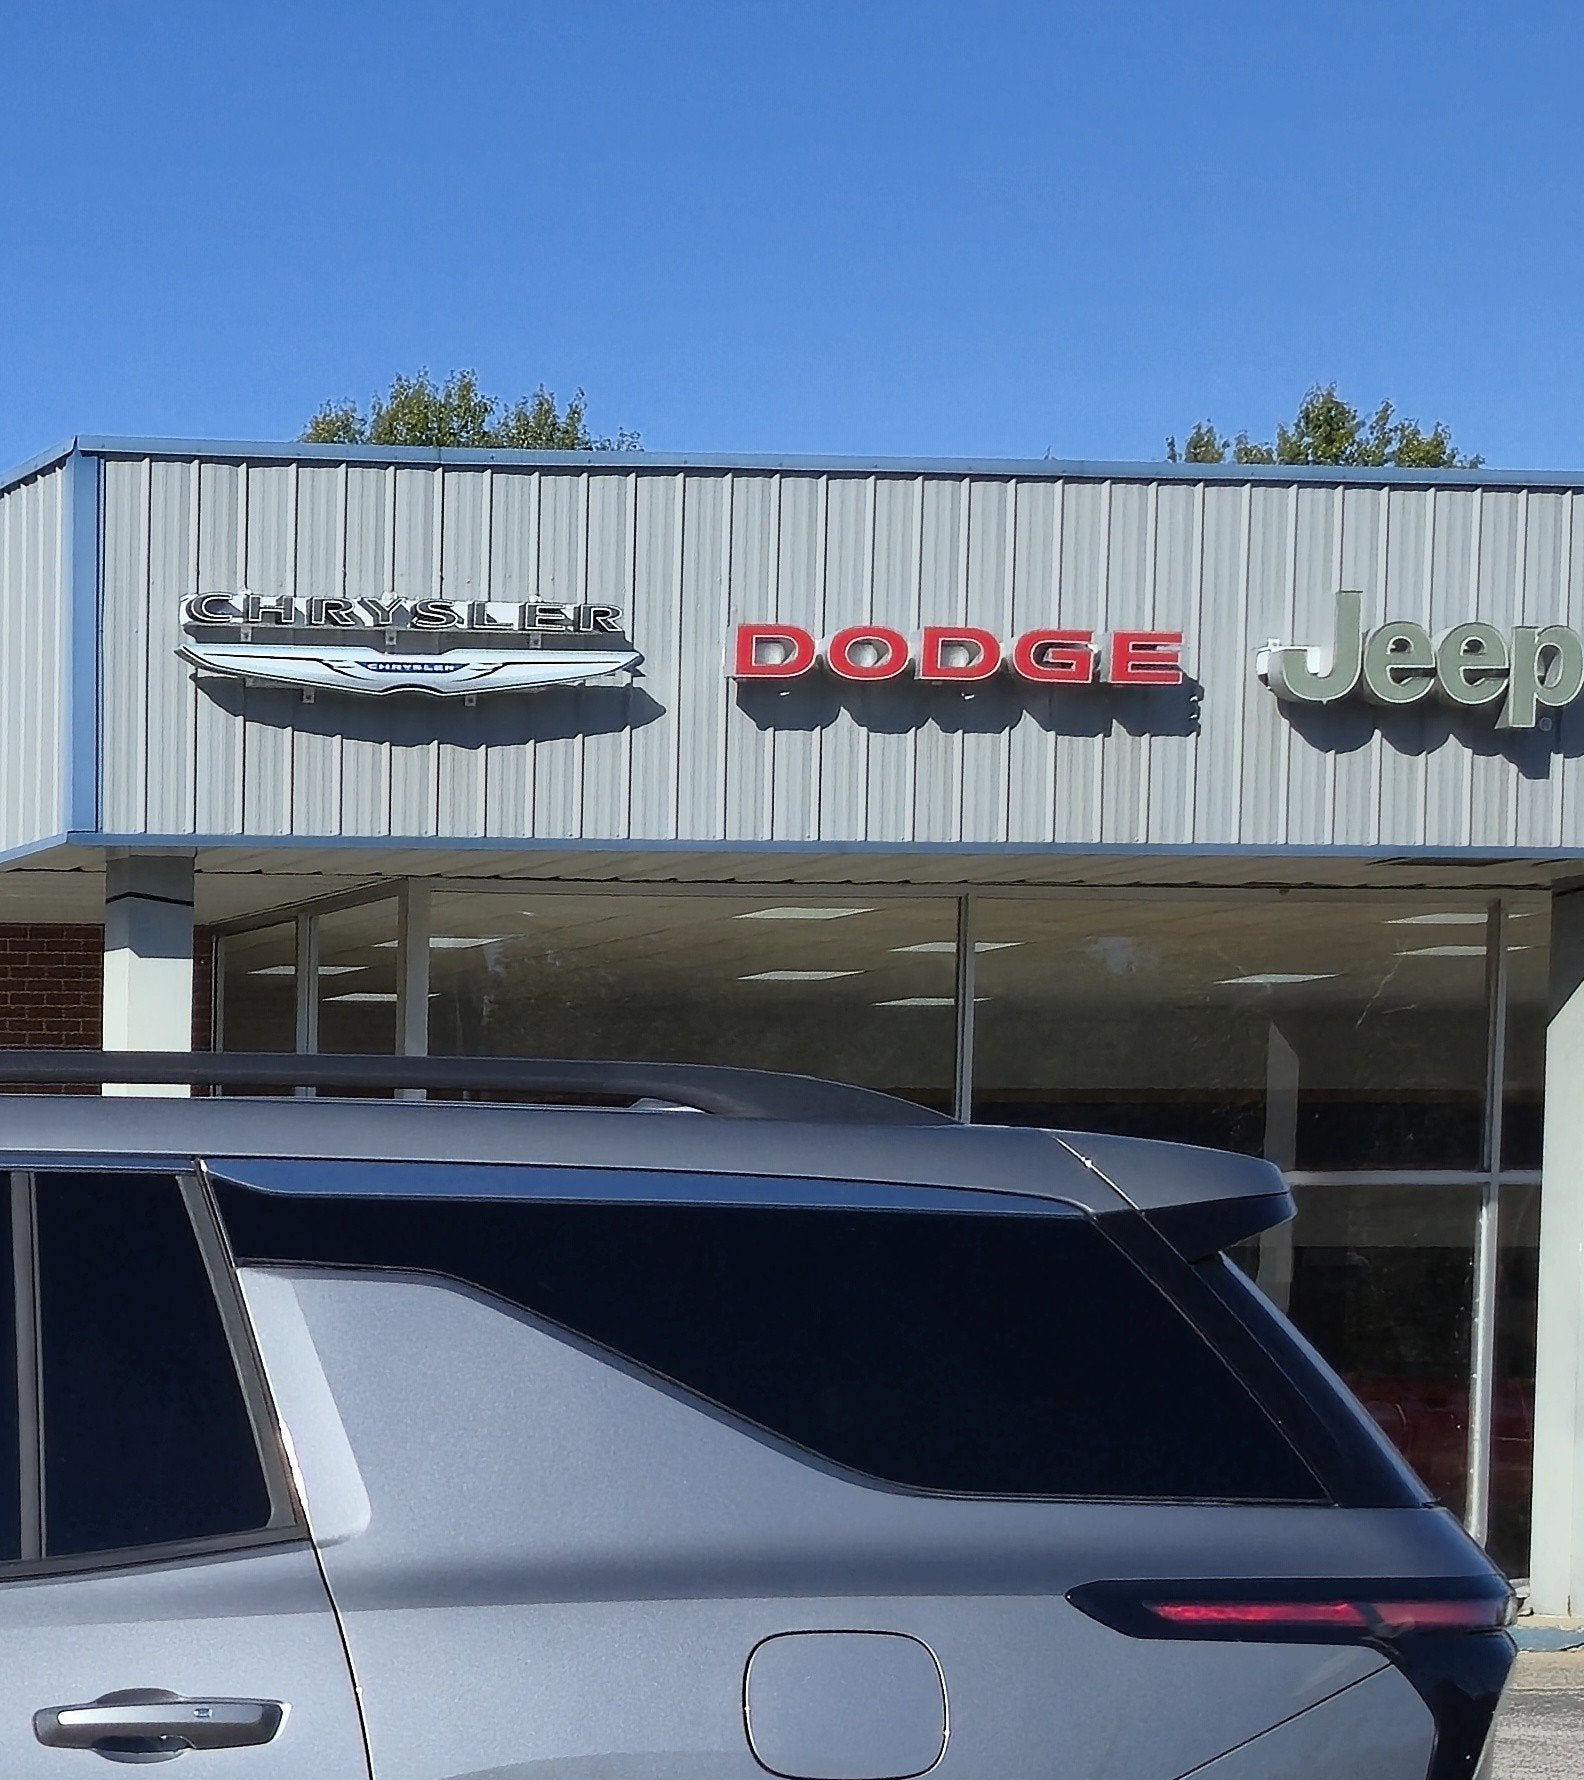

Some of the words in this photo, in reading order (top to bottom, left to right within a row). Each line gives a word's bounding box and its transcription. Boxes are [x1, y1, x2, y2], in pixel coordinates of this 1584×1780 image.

[190, 592, 625, 634] CHRYSLER
[366, 662, 455, 672] CHRYSLER
[735, 622, 1183, 686] DODGE
[1272, 590, 1584, 729] Jeep
